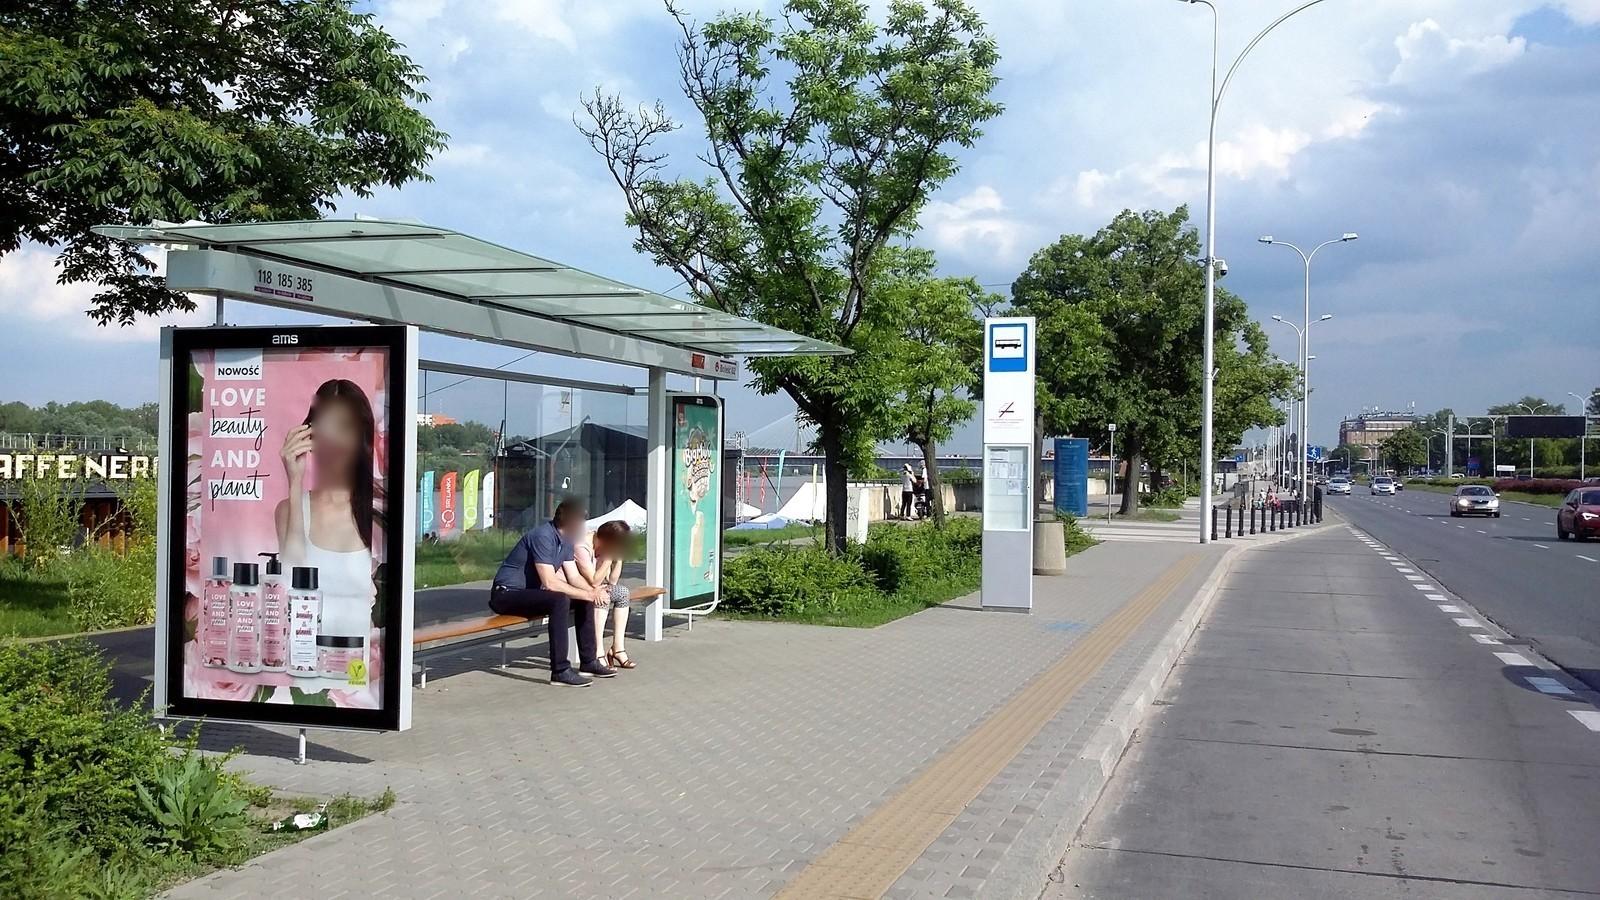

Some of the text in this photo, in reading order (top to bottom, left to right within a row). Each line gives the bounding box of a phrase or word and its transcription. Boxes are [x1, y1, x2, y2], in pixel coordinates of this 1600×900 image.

[257, 269, 313, 292] 118 185 385
[272, 334, 299, 344] ams
[217, 365, 260, 376] NOWOŚĆ
[210, 388, 266, 406] LOVE
[211, 407, 268, 451] beauty
[210, 450, 261, 468] AND
[210, 470, 270, 512] planet
